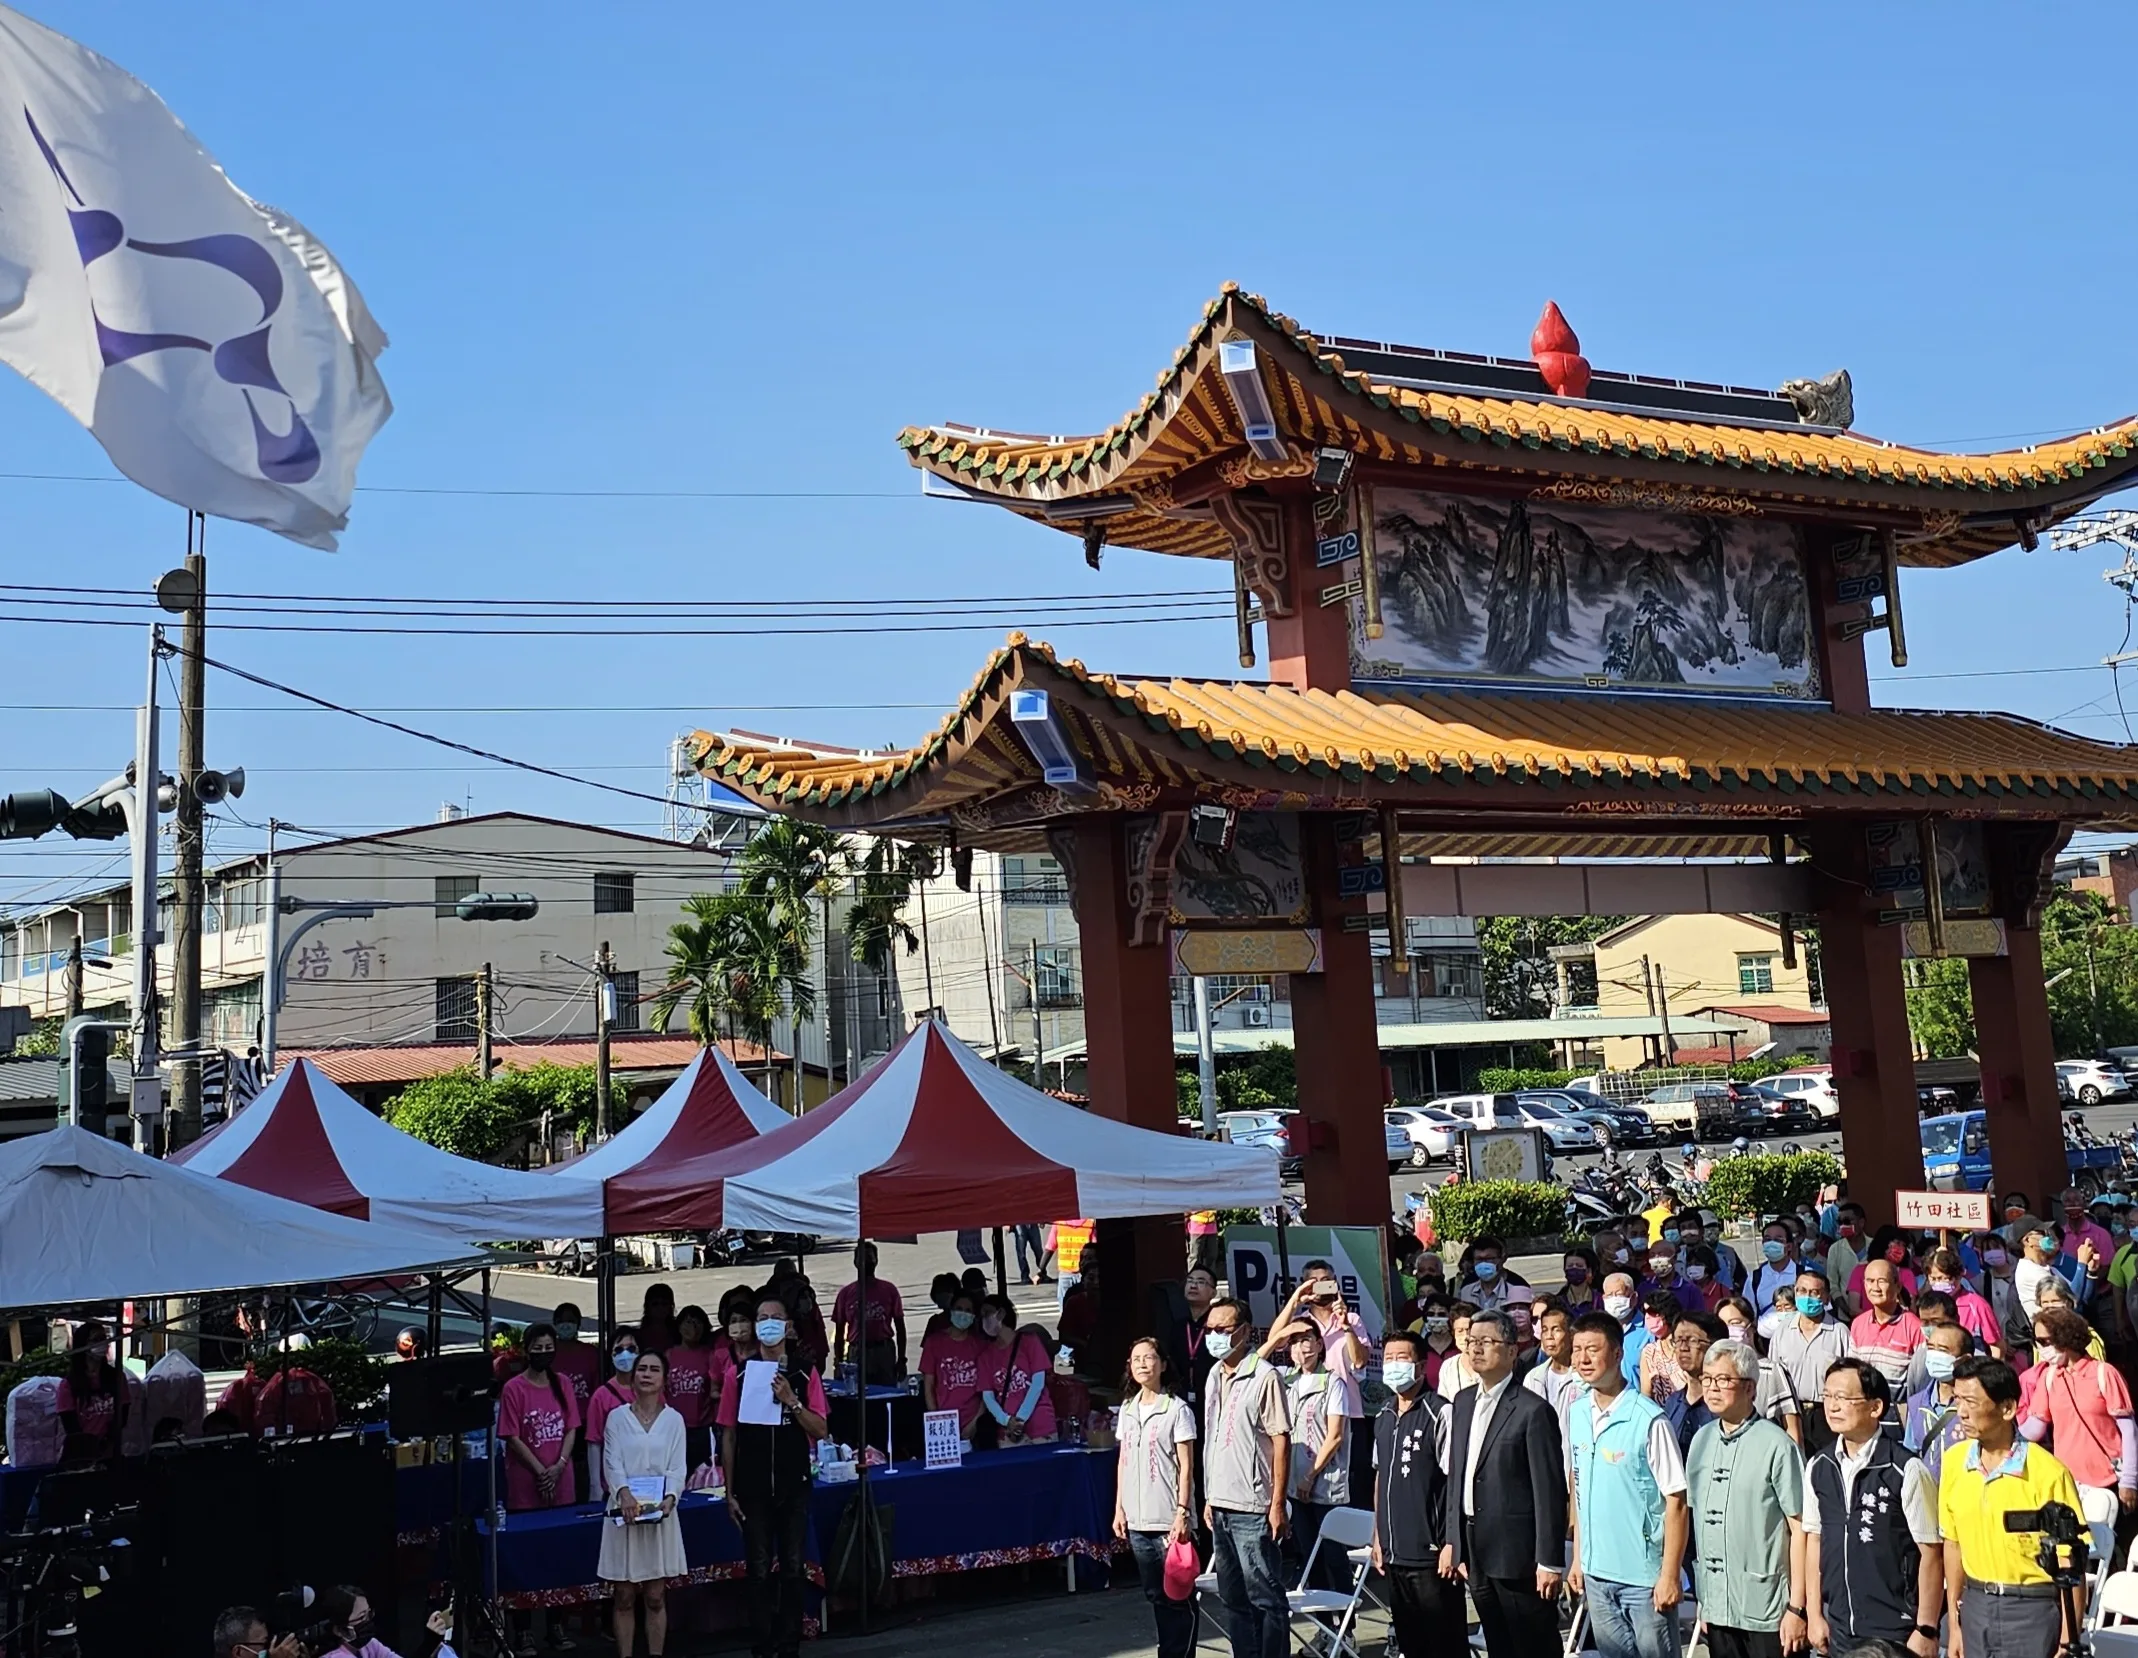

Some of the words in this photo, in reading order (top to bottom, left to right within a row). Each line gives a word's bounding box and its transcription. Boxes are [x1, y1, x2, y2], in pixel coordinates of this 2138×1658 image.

[1906, 1200, 1982, 1220] 竹田社區
[1233, 1249, 1269, 1304] P
